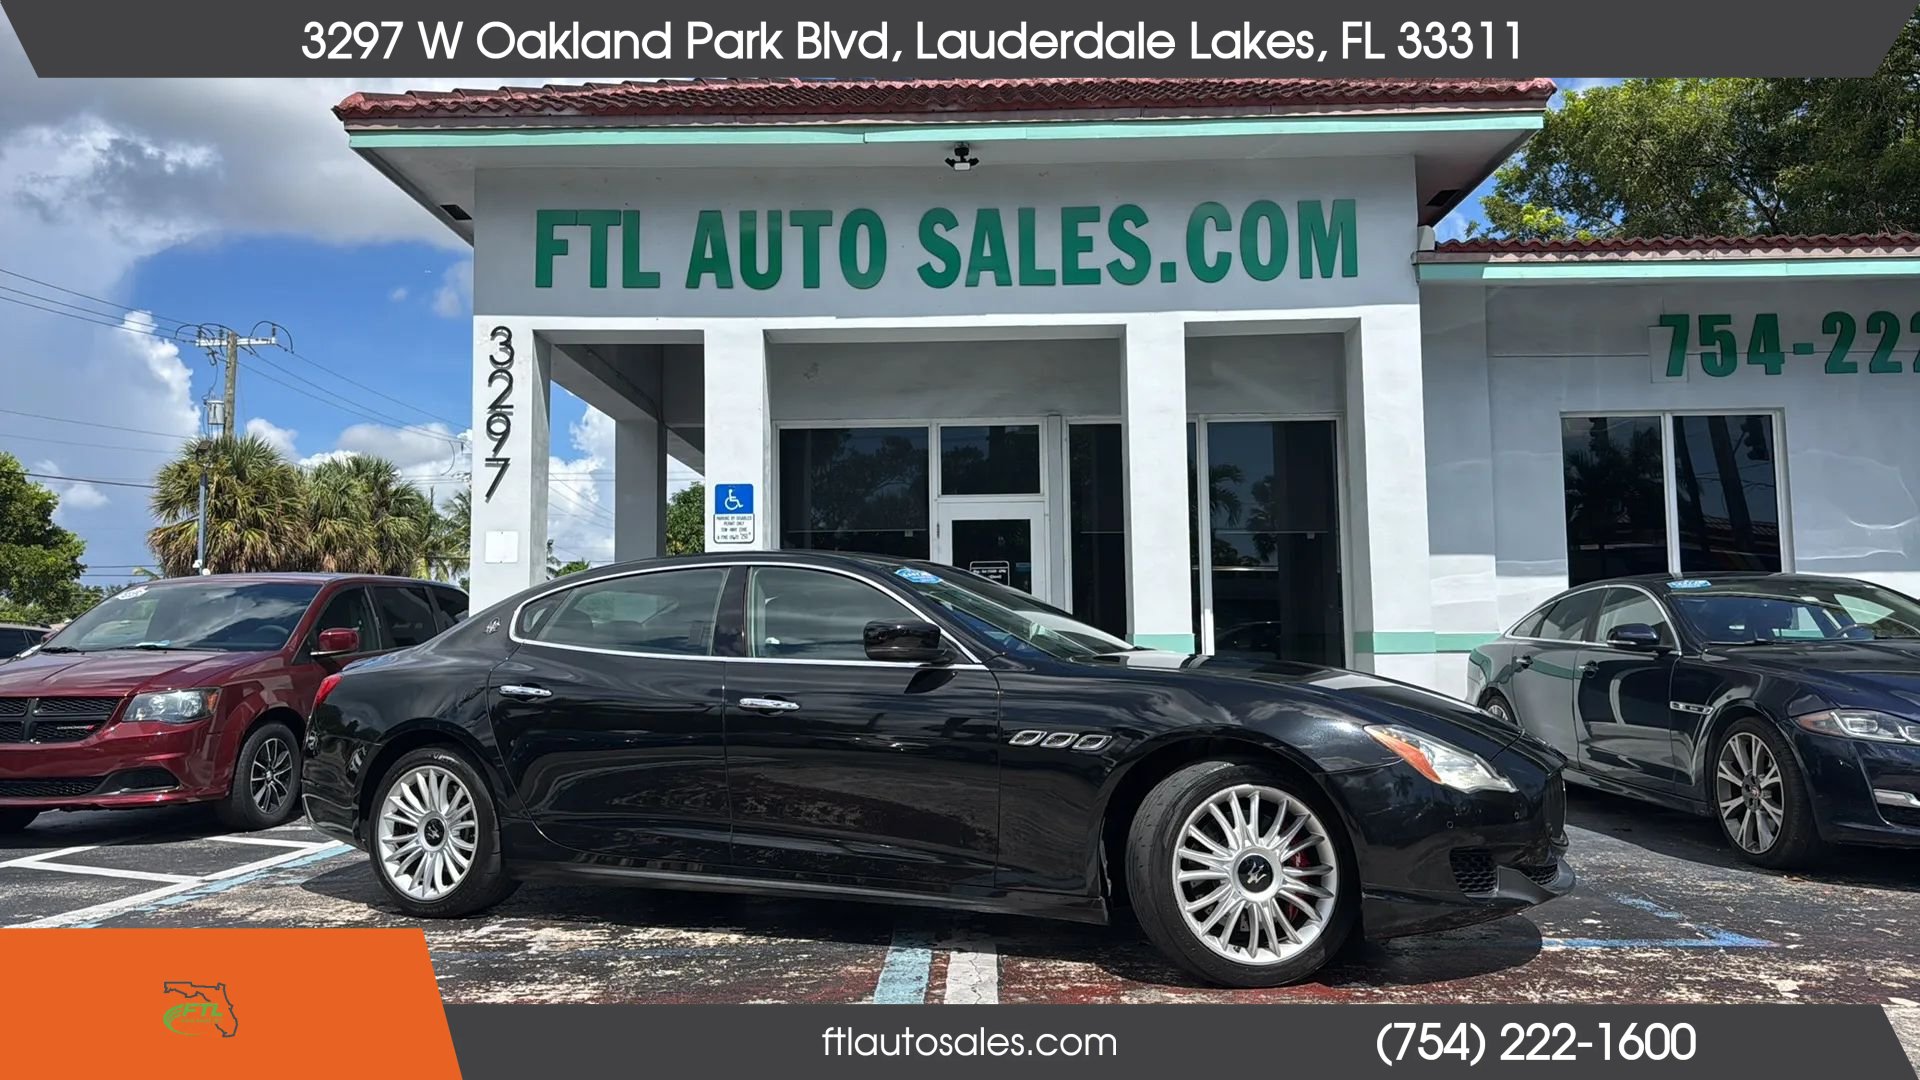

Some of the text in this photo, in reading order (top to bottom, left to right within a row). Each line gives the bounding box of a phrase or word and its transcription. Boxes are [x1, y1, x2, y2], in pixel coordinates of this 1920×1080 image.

[535, 199, 1359, 290] FTL AUTO SALES.COM
[485, 325, 515, 503] 3297
